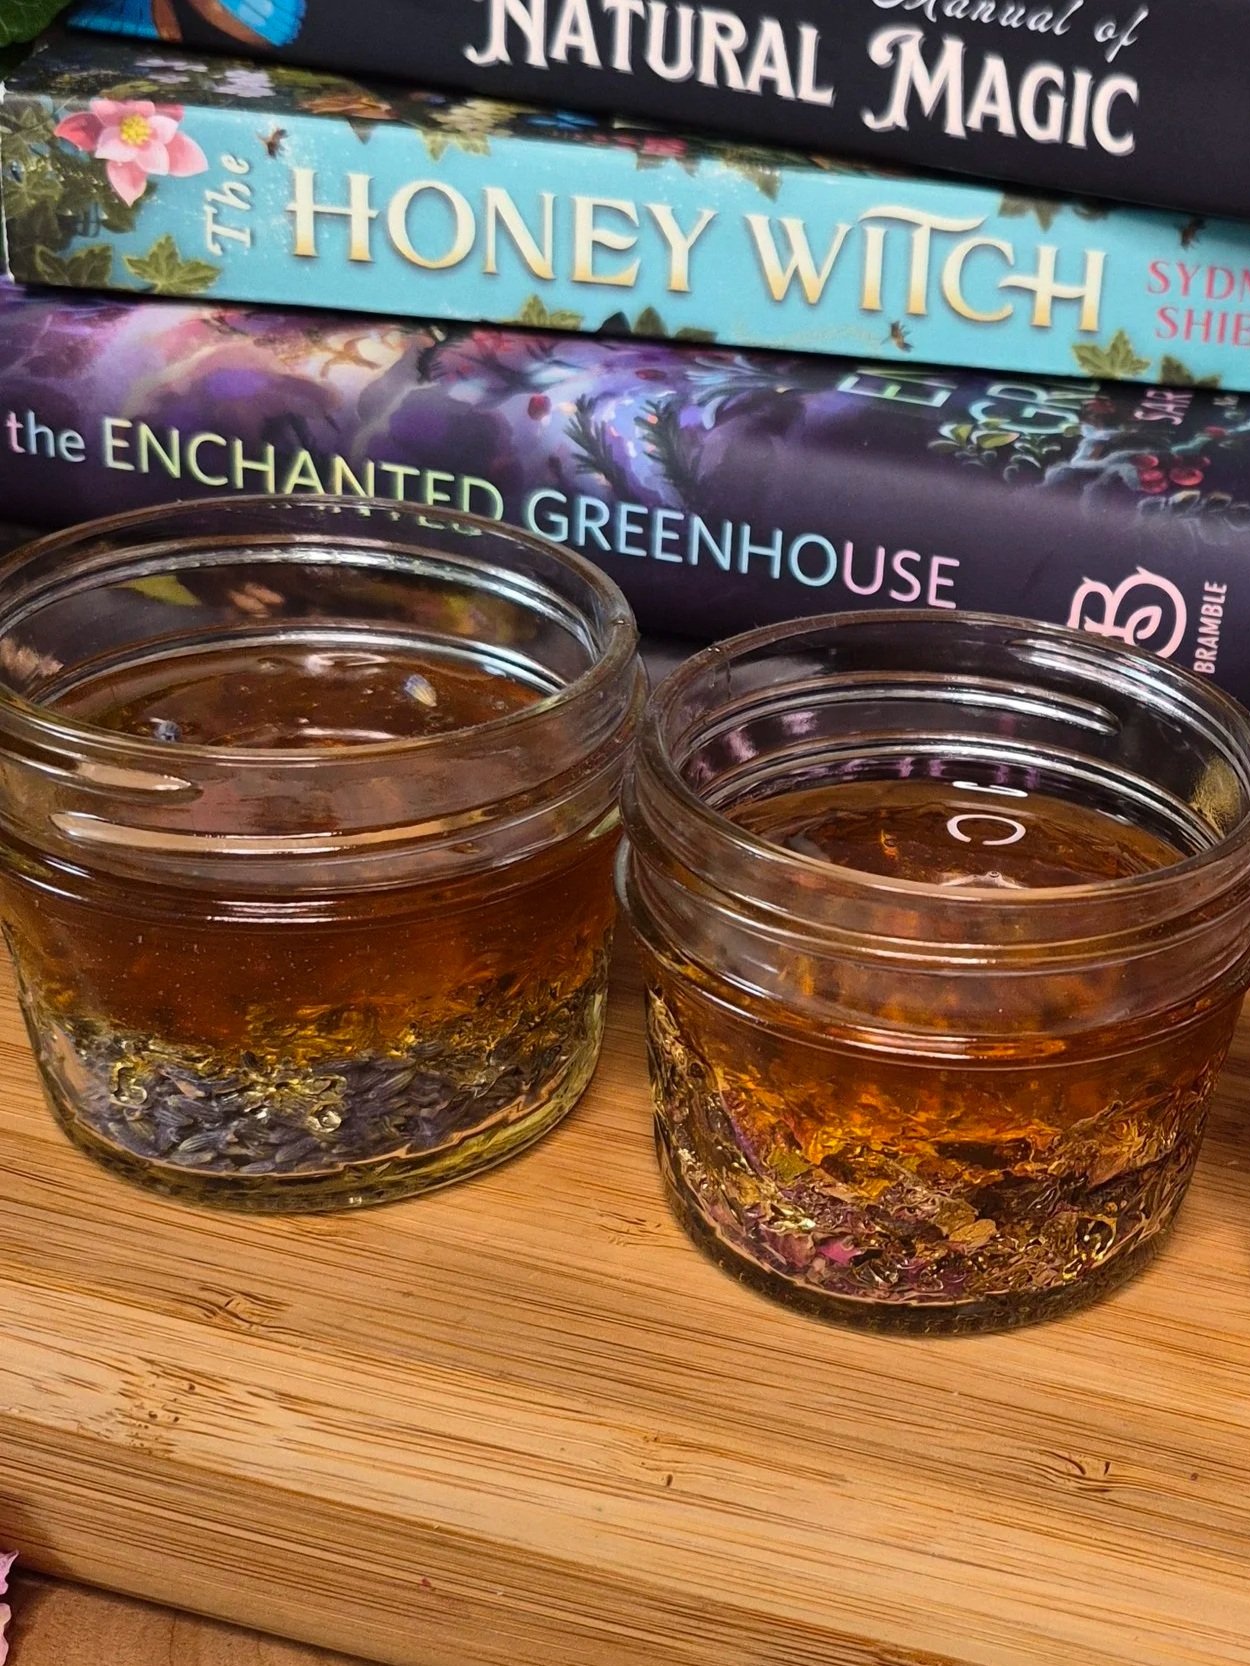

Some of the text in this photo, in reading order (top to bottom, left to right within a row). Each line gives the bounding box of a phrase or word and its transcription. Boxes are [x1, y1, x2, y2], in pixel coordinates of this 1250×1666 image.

[463, 0, 1139, 155] NATURAL MAGIC
[1094, 5, 1149, 62] of
[204, 153, 252, 257] The
[285, 167, 1107, 332] HONEY WITCH
[5, 409, 961, 610] the ENCHANTED GREENHOUSE
[1193, 580, 1228, 675] BRAMBLE
